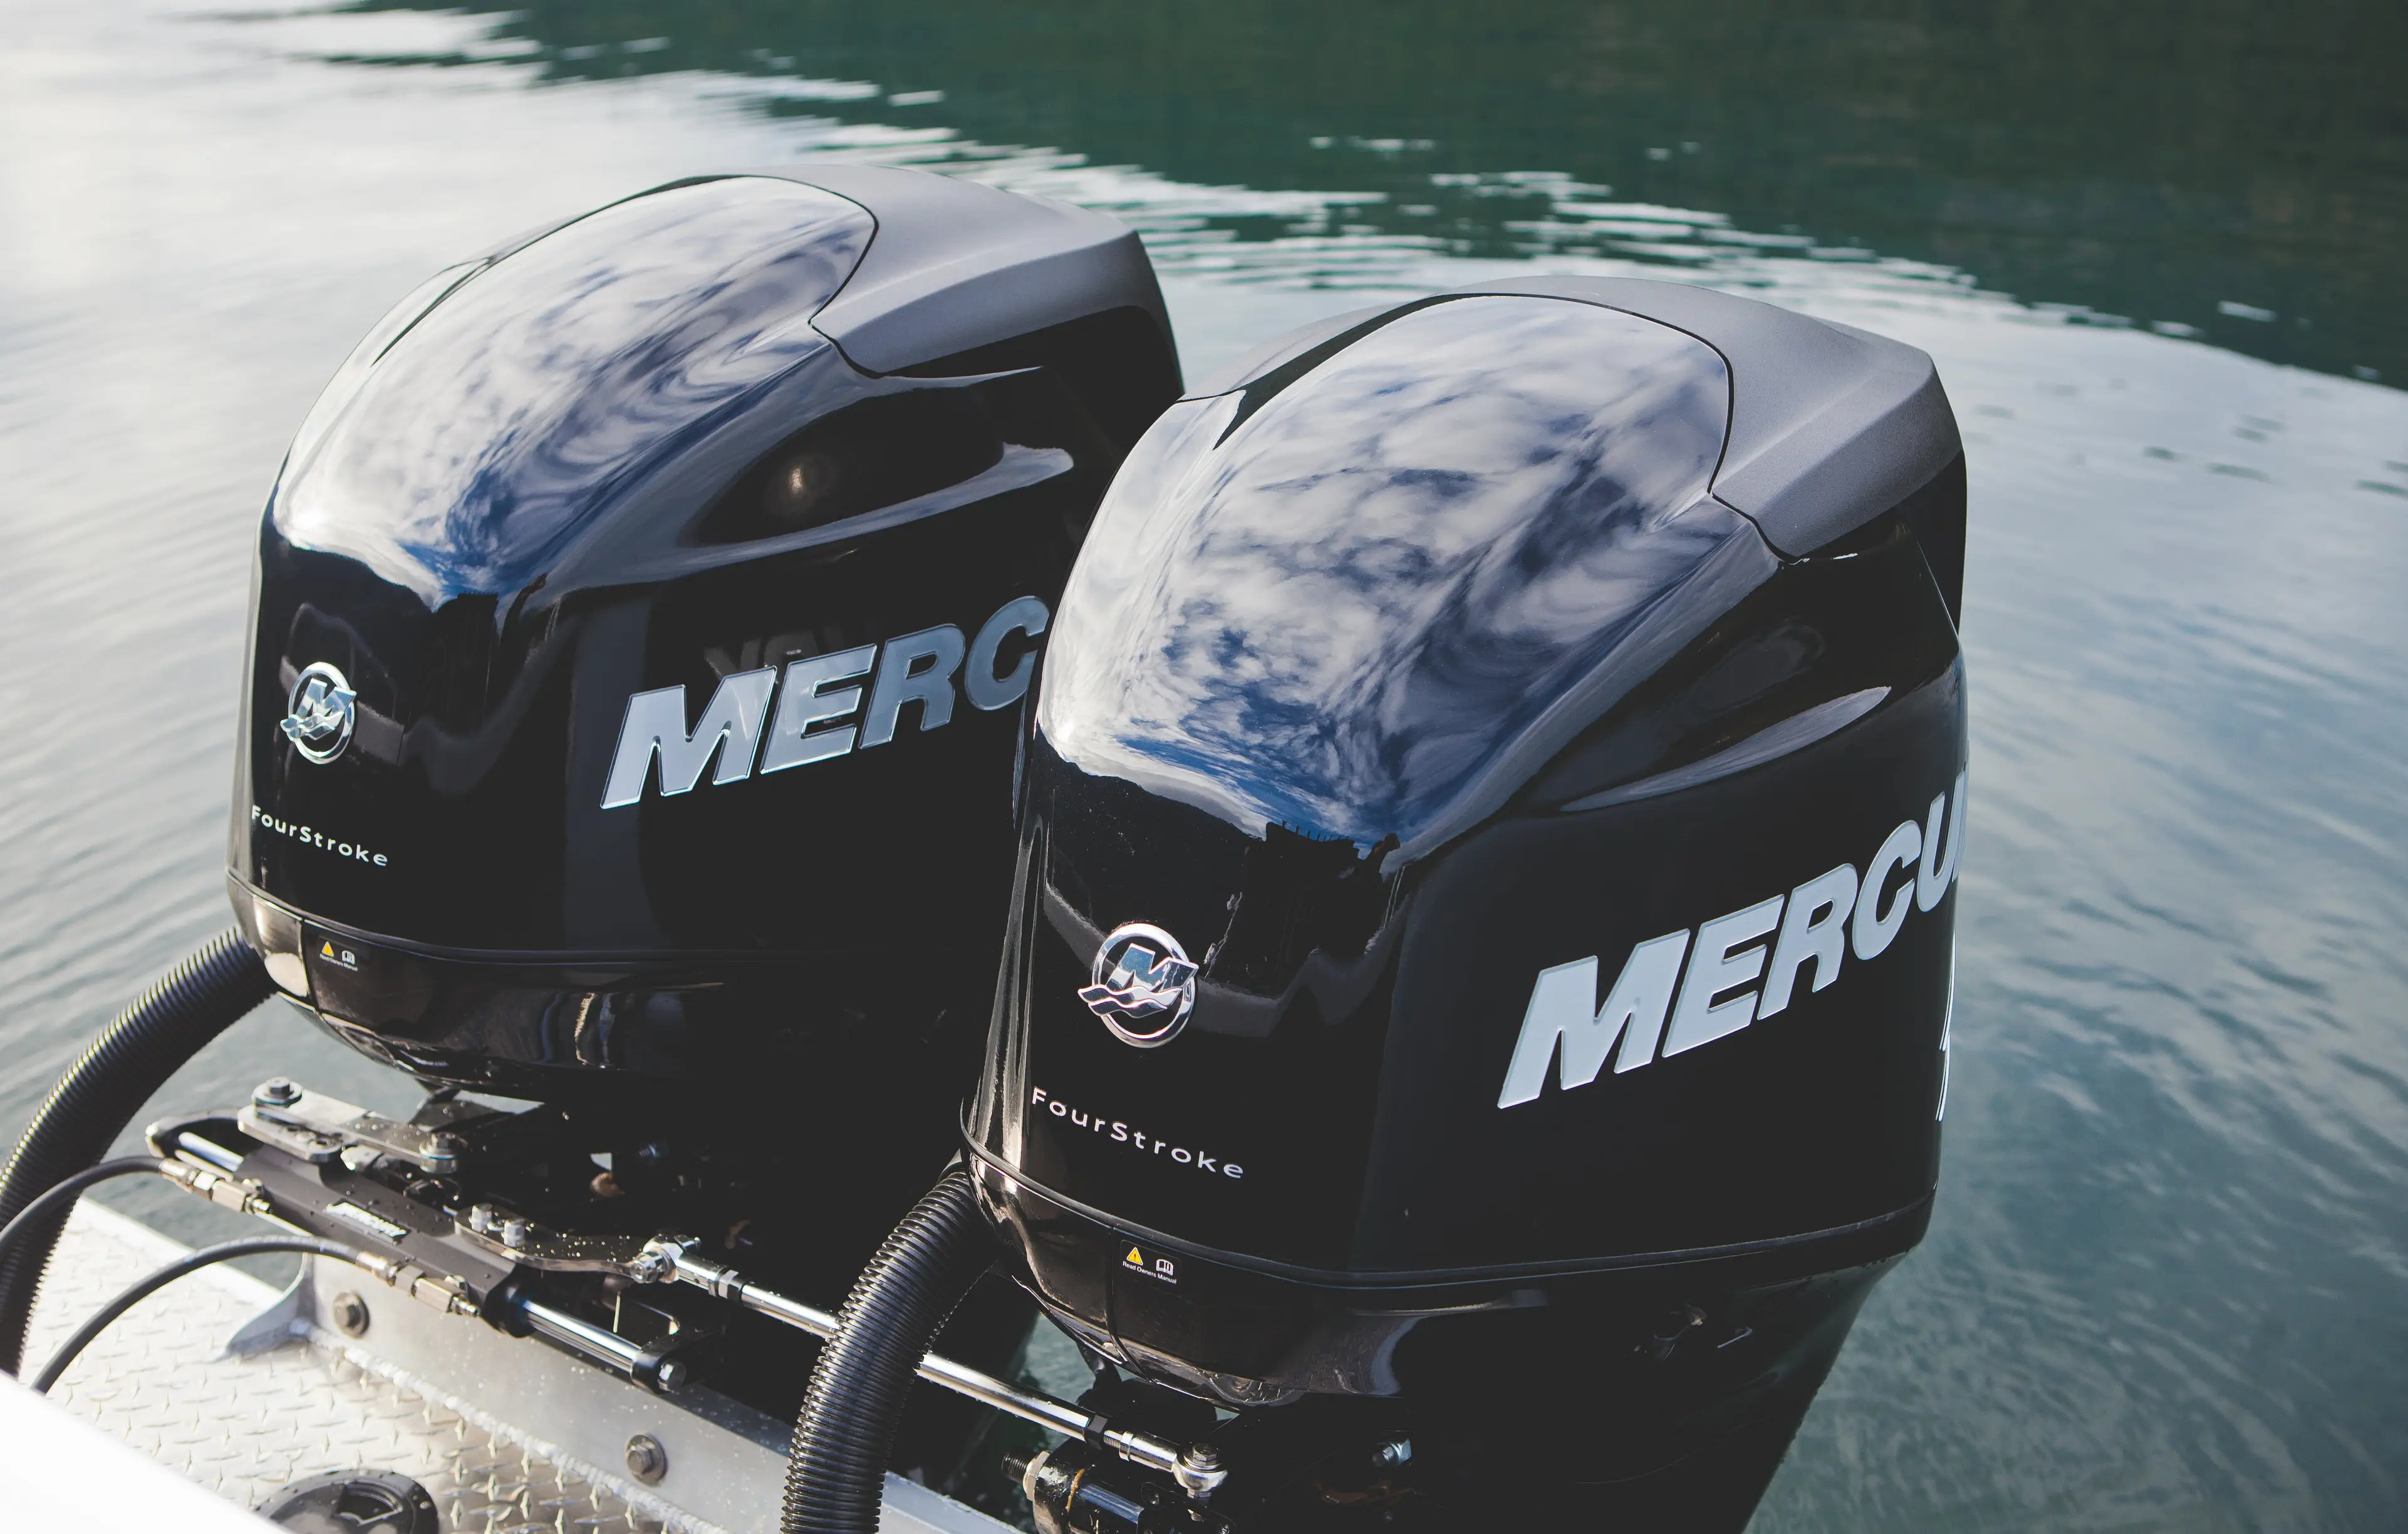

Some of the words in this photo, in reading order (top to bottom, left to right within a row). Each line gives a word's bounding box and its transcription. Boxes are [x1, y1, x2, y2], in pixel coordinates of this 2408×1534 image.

[251, 805, 388, 867] FourStroke
[1497, 762, 1967, 1109] MERCU
[1031, 1086, 1243, 1179] FourStroke
[1123, 1261, 1136, 1270] Read
[1137, 1266, 1157, 1278] Owners
[1158, 1273, 1176, 1284] Manual
